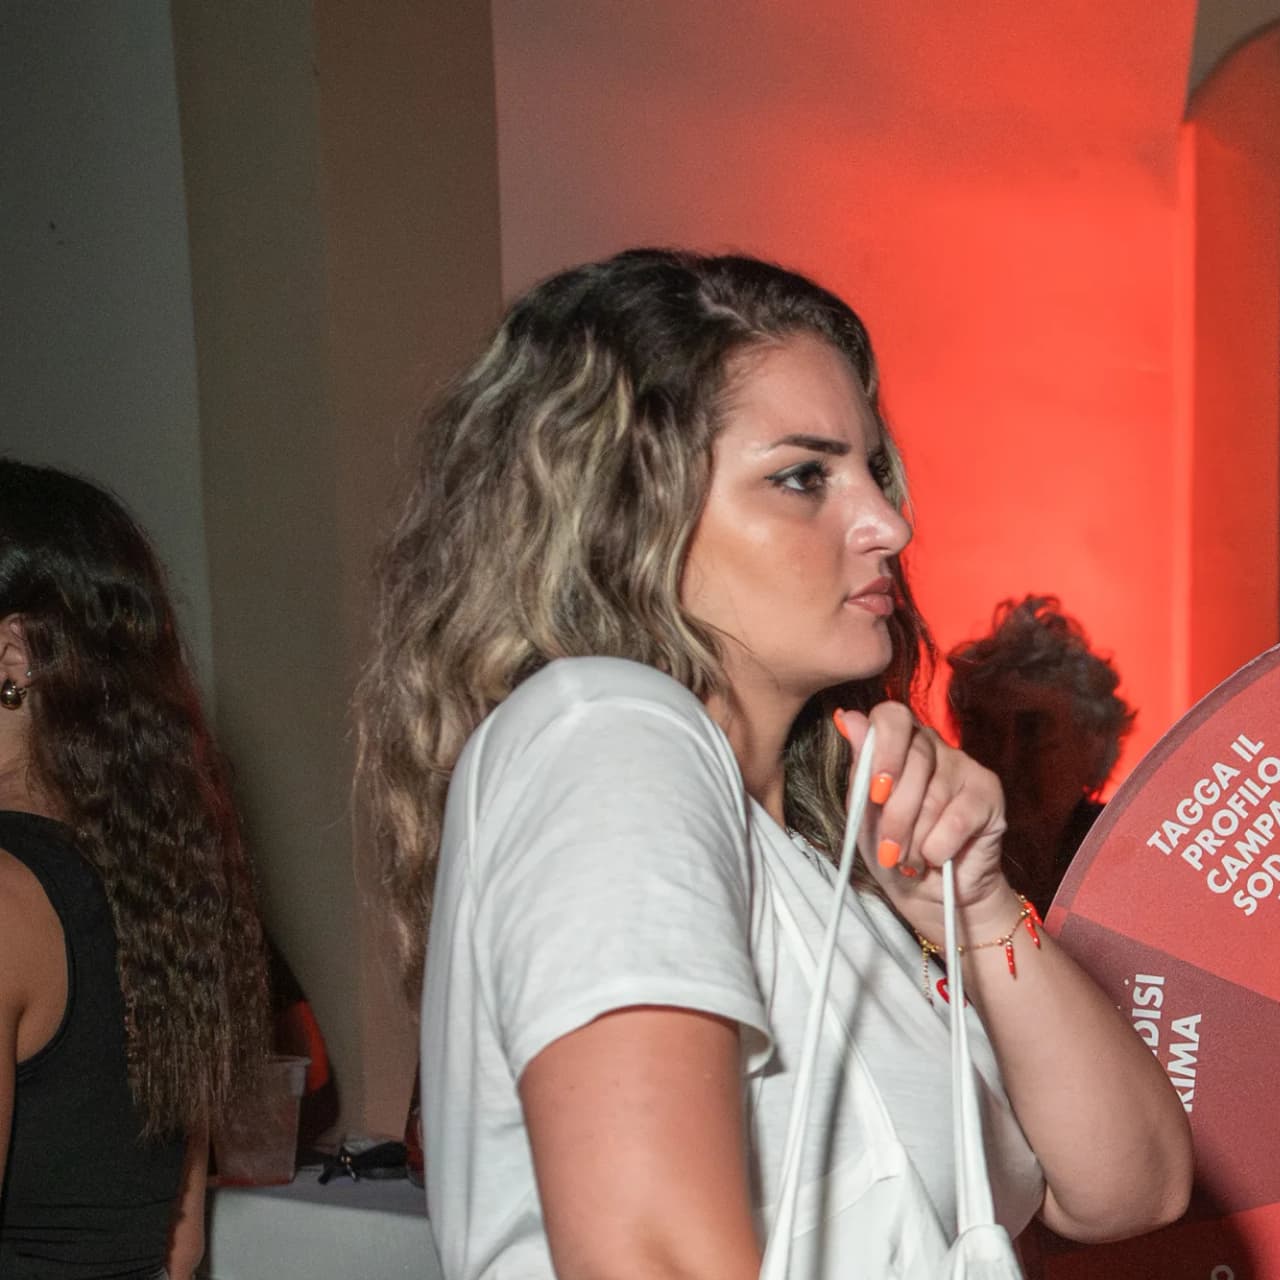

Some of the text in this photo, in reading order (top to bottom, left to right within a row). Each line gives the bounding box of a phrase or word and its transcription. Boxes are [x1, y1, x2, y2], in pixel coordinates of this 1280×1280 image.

[1146, 734, 1264, 855] TAGGA IL
[1132, 974, 1165, 1047] DISI
